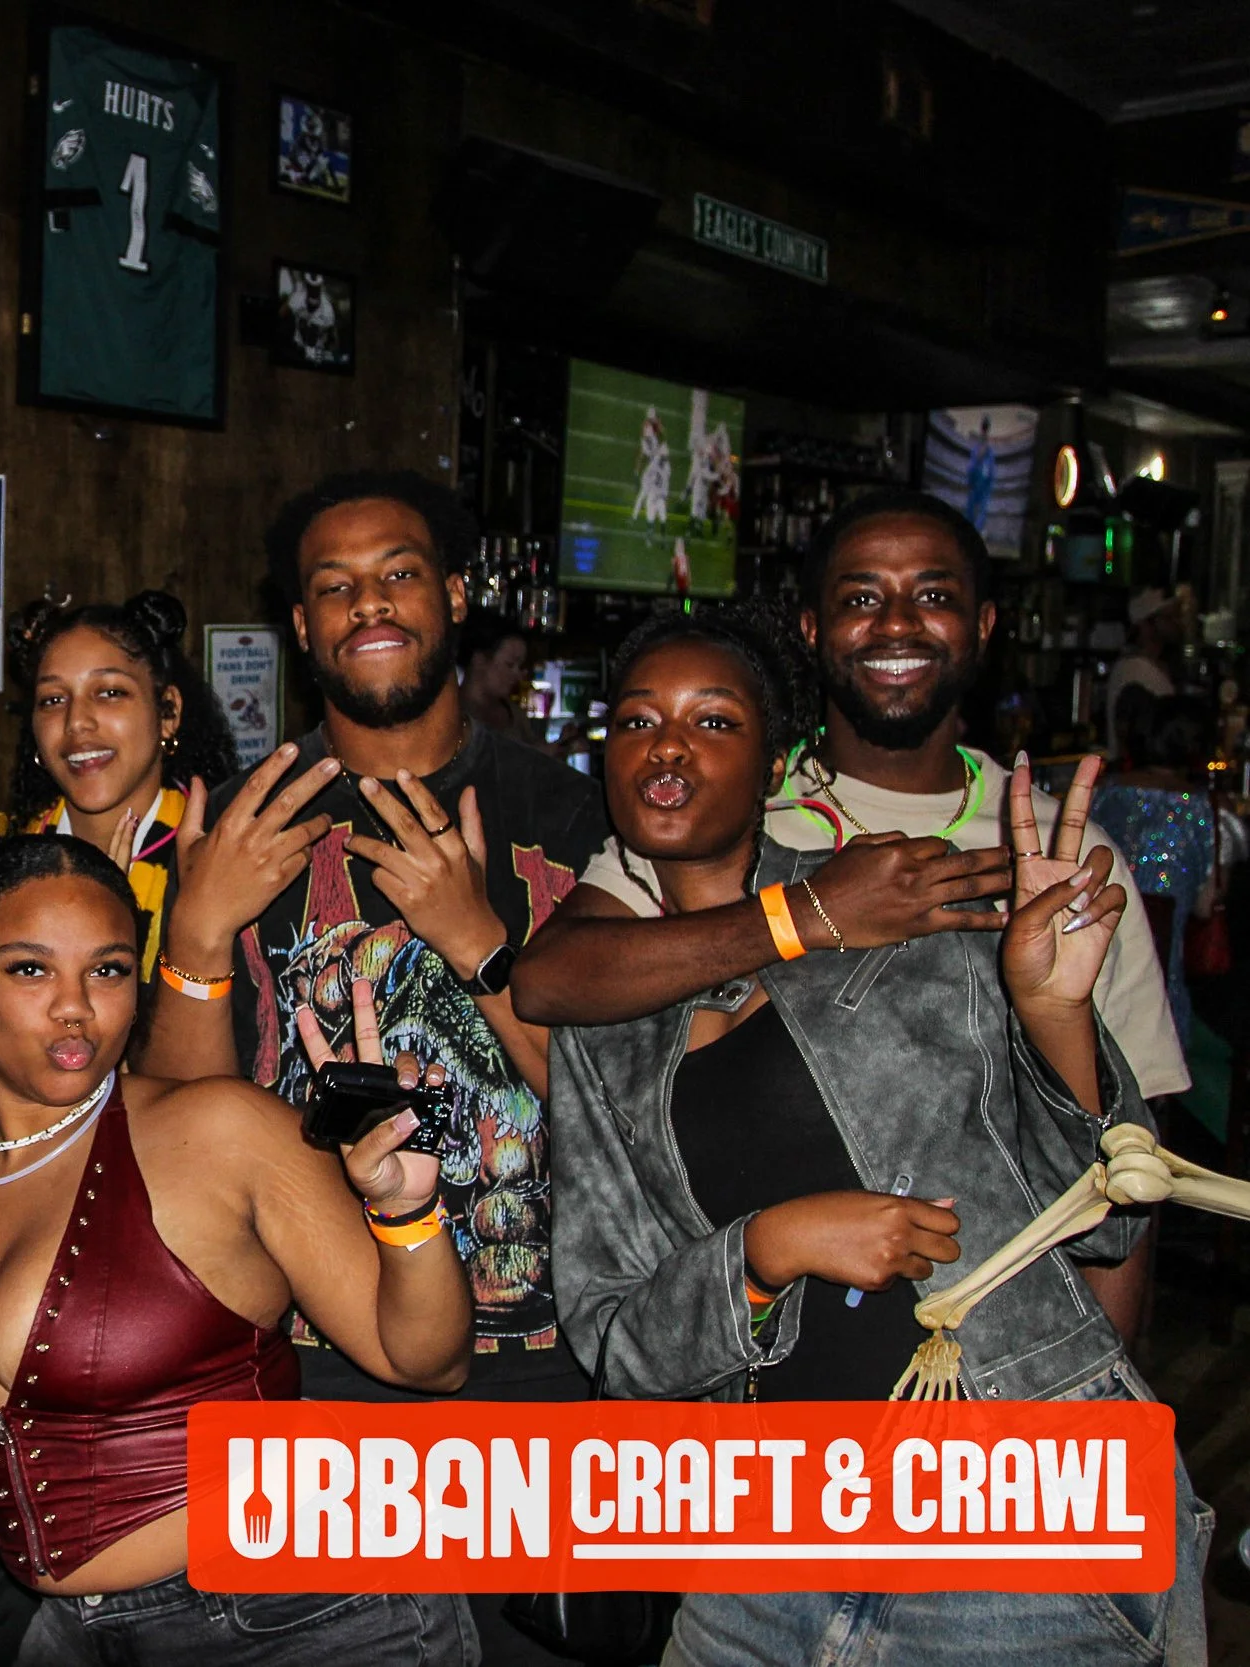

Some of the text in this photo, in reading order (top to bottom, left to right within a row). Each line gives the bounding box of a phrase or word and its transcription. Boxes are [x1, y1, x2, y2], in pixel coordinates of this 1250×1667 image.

[104, 80, 174, 132] HURTS
[118, 153, 149, 272] 1
[220, 648, 270, 658] FOOTBALL
[217, 659, 274, 672] FANS DON'T
[231, 674, 261, 685] DRINK
